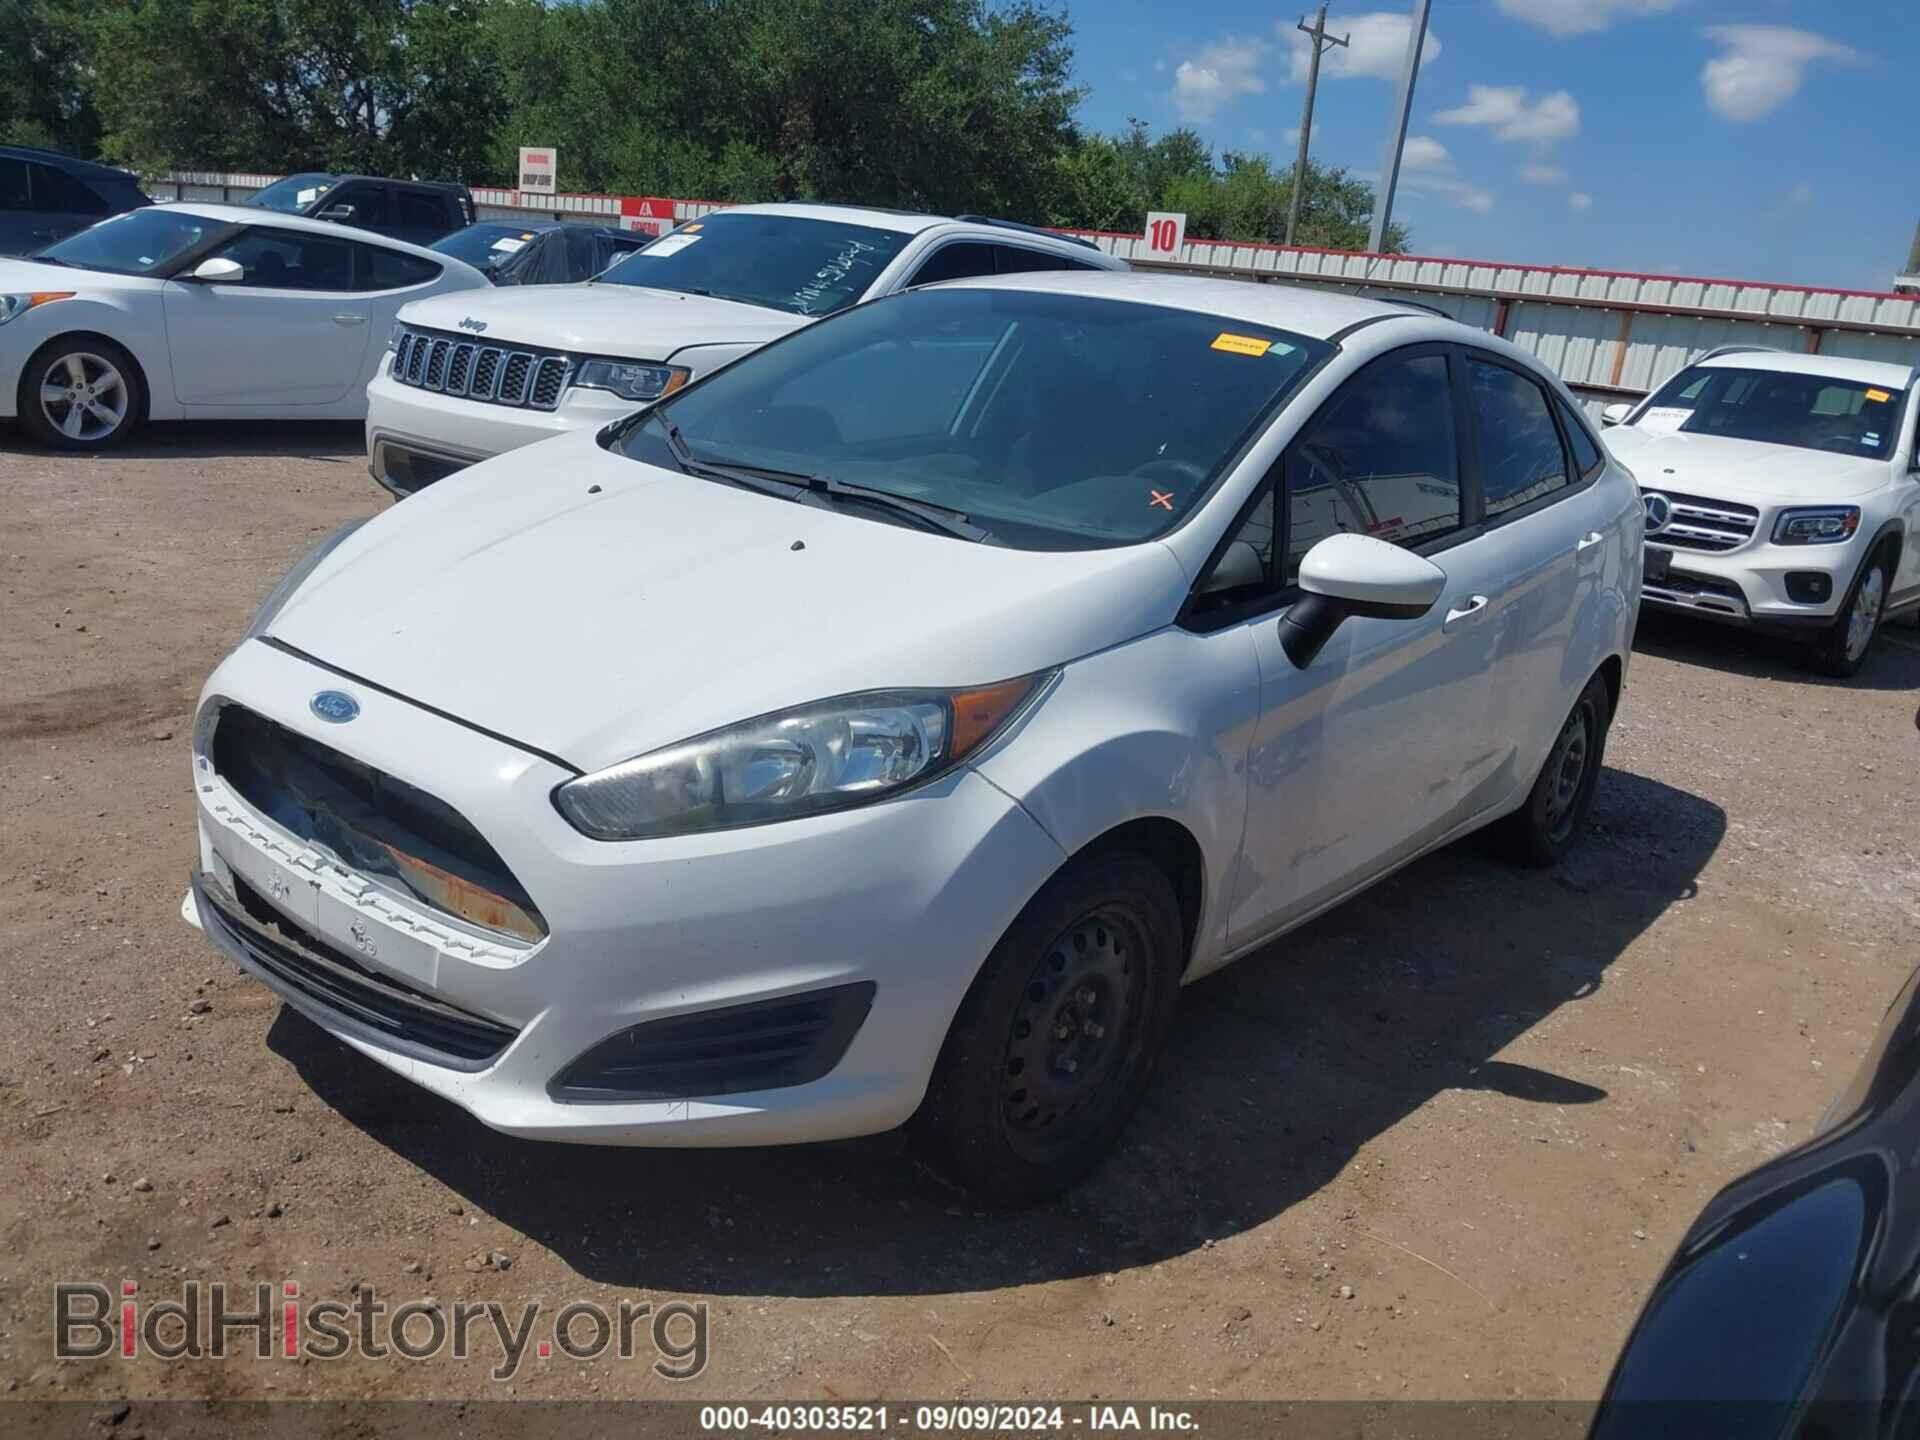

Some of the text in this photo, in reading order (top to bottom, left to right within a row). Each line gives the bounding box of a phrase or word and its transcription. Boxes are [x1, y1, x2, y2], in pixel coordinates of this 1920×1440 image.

[1151, 220, 1177, 252] 10
[458, 315, 488, 334] Jeep
[316, 694, 351, 717] Ford
